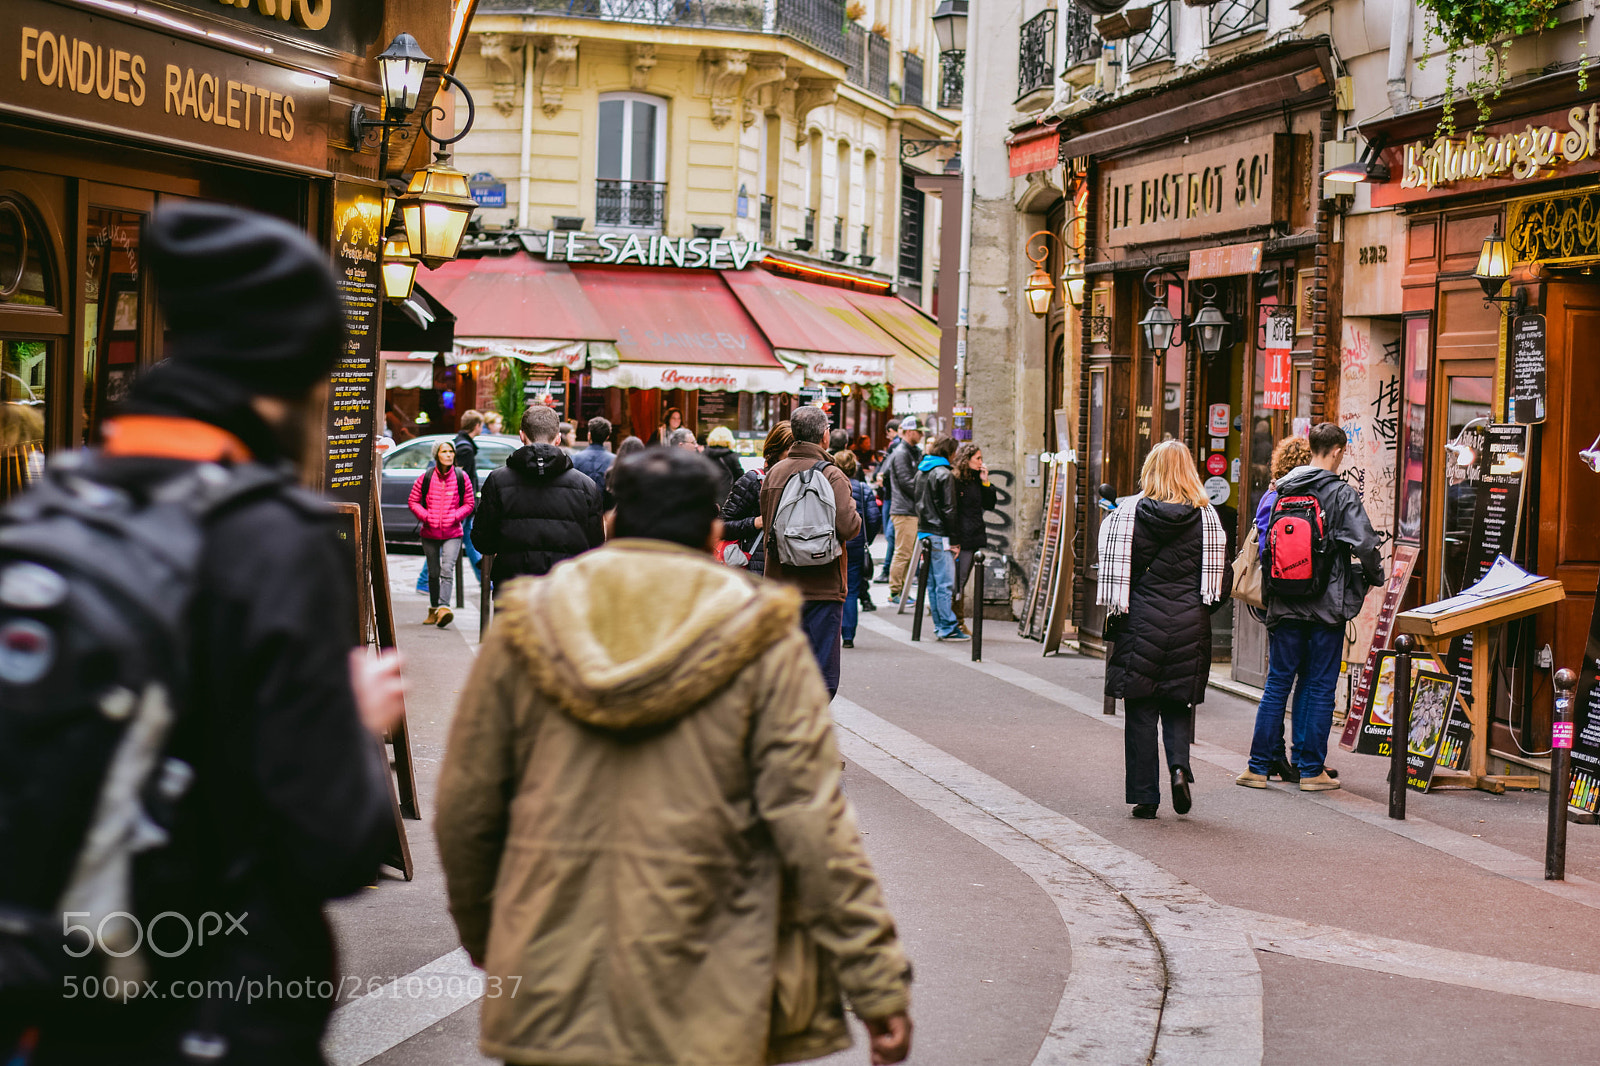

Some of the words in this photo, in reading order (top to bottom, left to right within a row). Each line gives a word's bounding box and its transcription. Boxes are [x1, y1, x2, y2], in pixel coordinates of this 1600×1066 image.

[19, 26, 147, 107] FONDUES
[165, 63, 296, 142] RACLETTES
[1112, 184, 1133, 230] LE
[1140, 165, 1227, 225] BISTROT
[660, 369, 737, 385] Brasserie
[1364, 725, 1387, 735] Cuisses
